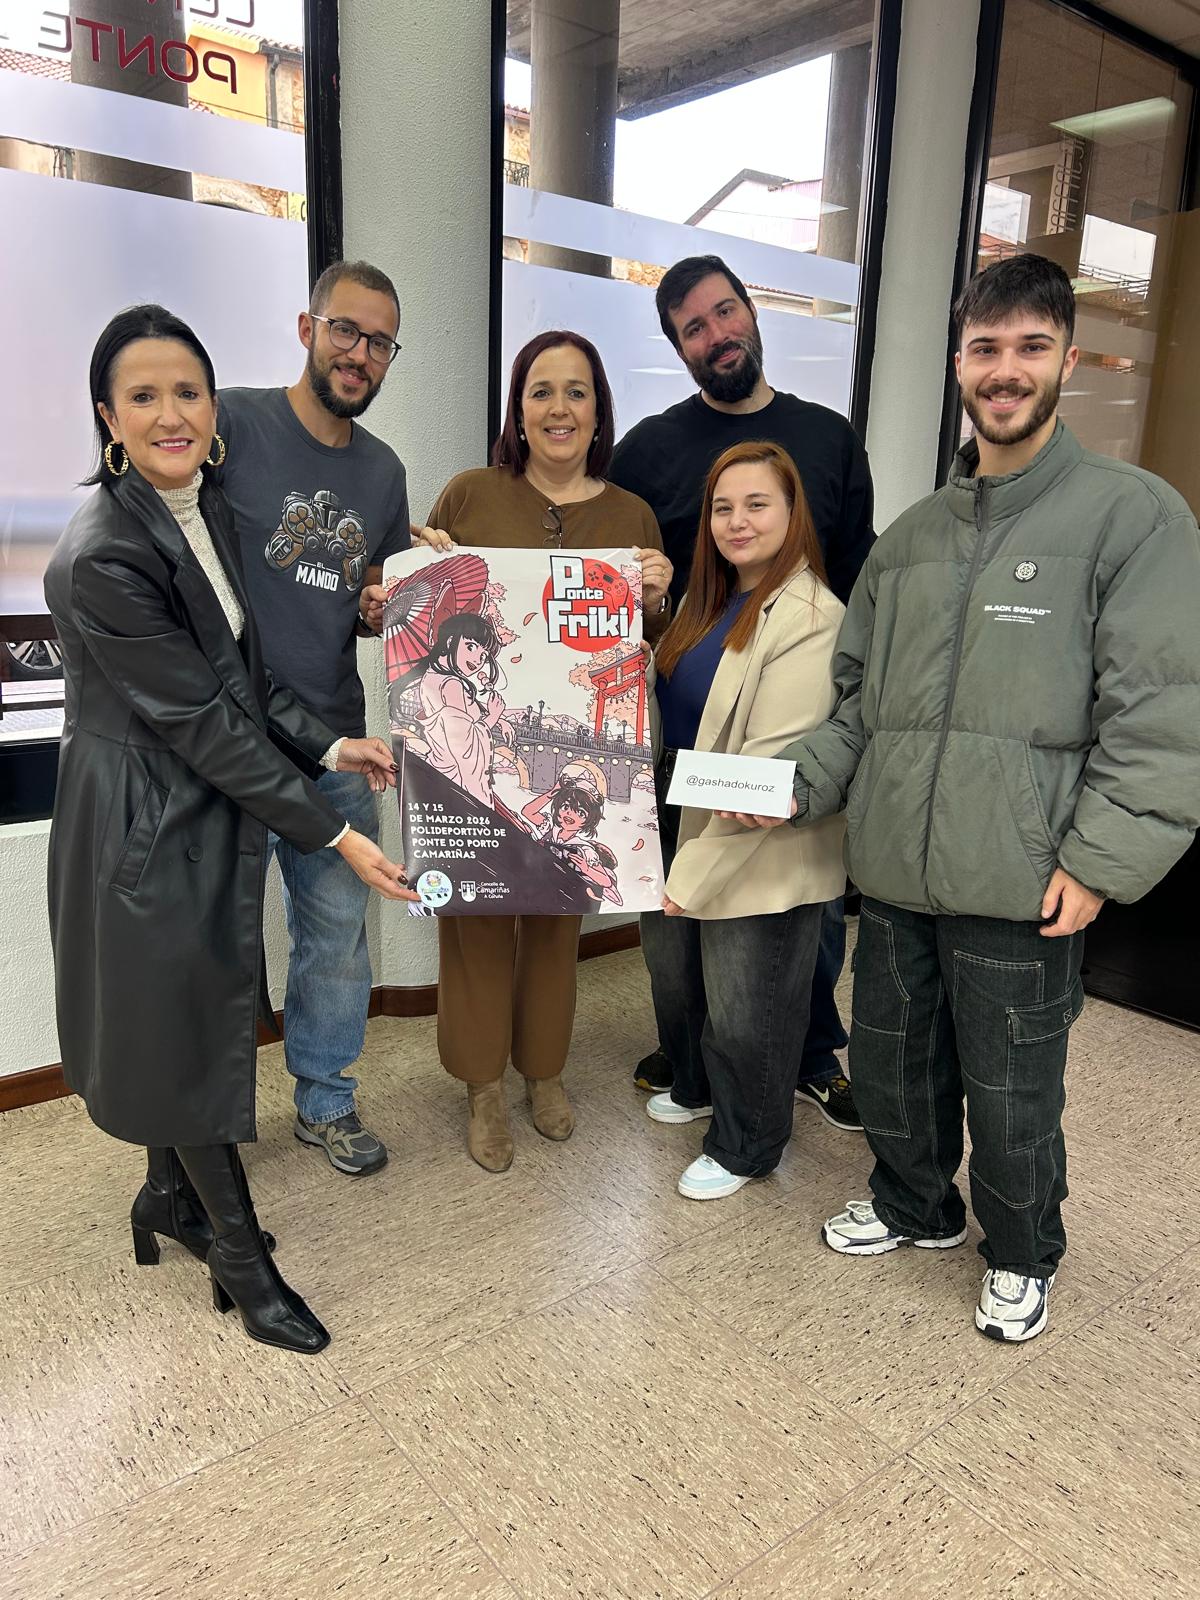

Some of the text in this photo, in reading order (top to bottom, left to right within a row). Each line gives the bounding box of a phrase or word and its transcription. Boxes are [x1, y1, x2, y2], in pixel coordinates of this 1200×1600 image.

[295, 564, 340, 592] MANDO
[549, 554, 605, 600] Ponte
[546, 599, 630, 643] Friki
[686, 774, 776, 793] @gashadokuroz
[408, 802, 444, 812] 14 Y 15
[409, 814, 491, 825] DE MARZO 2026
[410, 826, 507, 837] POLIDEPORTIVO DE
[411, 838, 500, 848] PONTE DO PORTO
[413, 848, 476, 859] CAMARIÑAS
[475, 886, 510, 894] Camariñas
